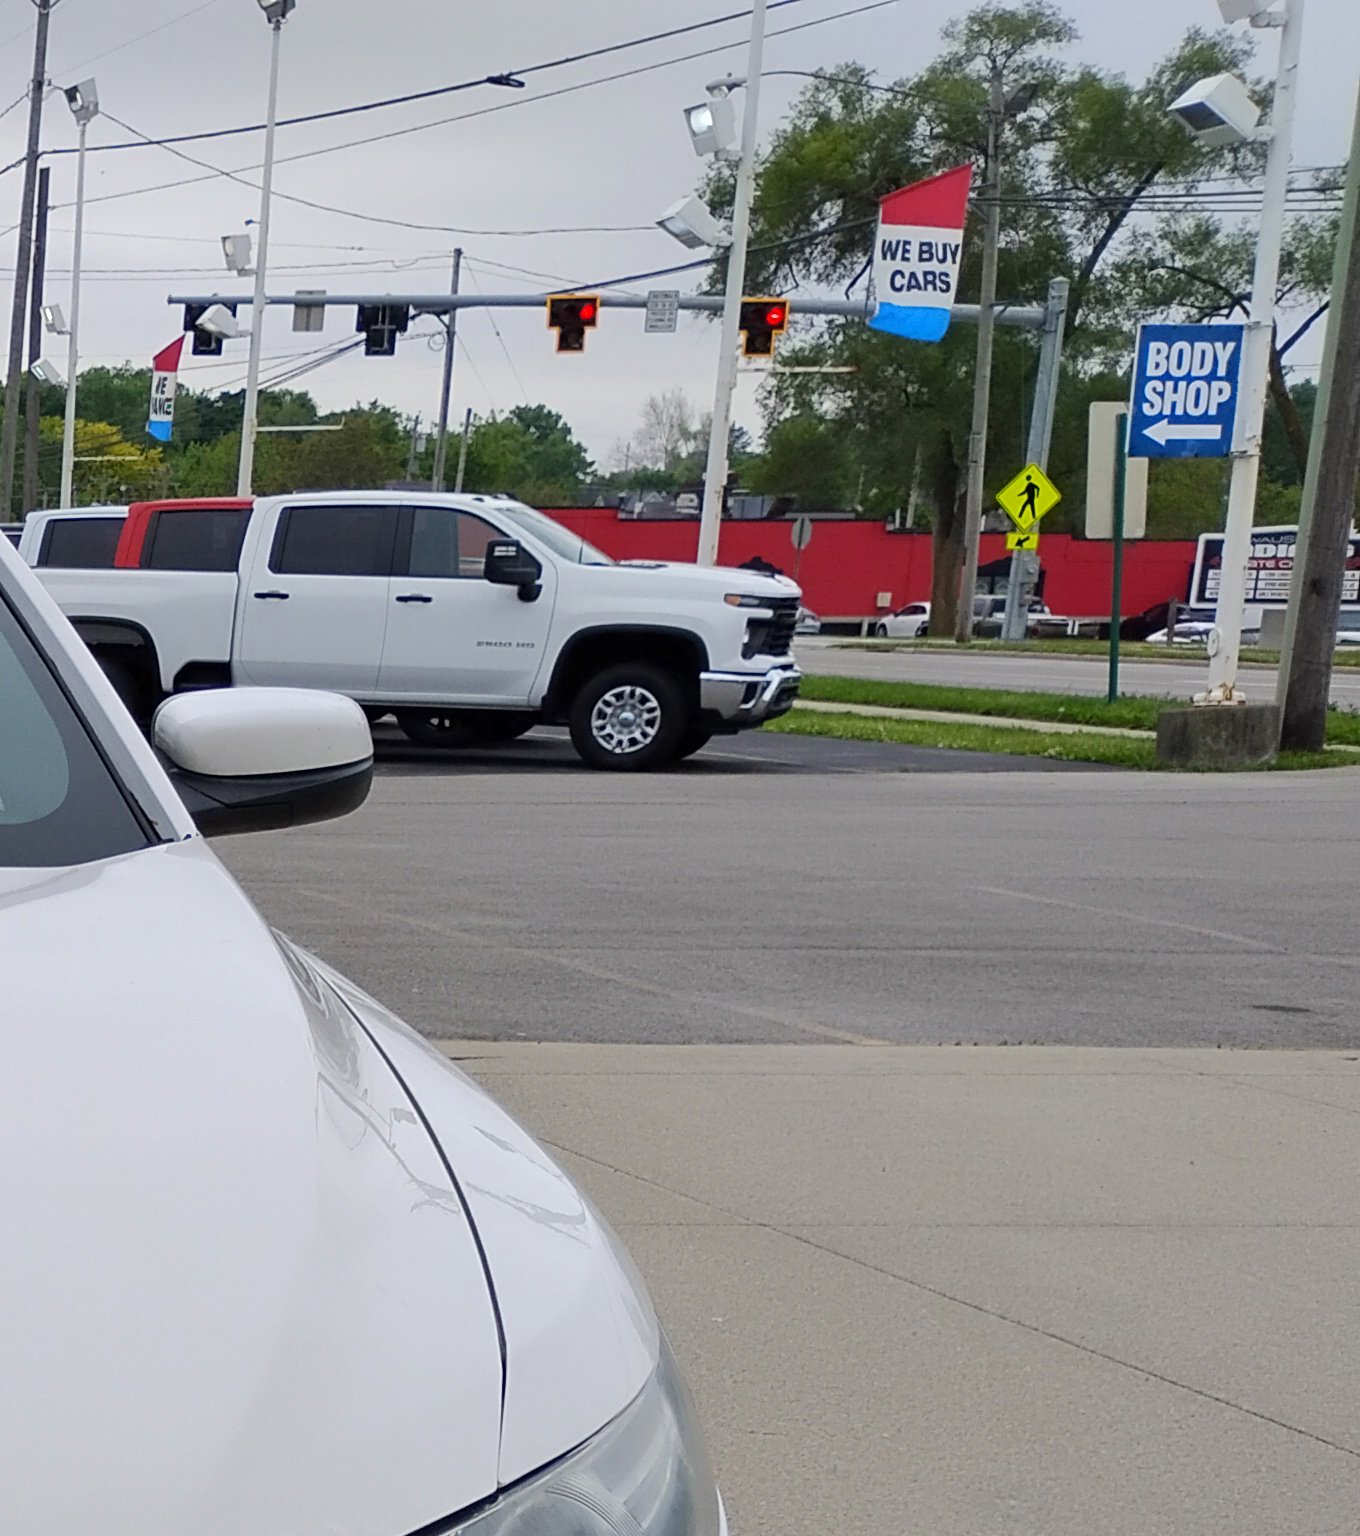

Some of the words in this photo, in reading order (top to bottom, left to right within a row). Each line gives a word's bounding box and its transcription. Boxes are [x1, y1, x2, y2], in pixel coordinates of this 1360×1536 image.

[881, 239, 911, 262] WE
[918, 241, 960, 264] BUY
[889, 269, 951, 293] CARS
[1146, 341, 1236, 377] BODY
[1142, 380, 1231, 416] SHOP
